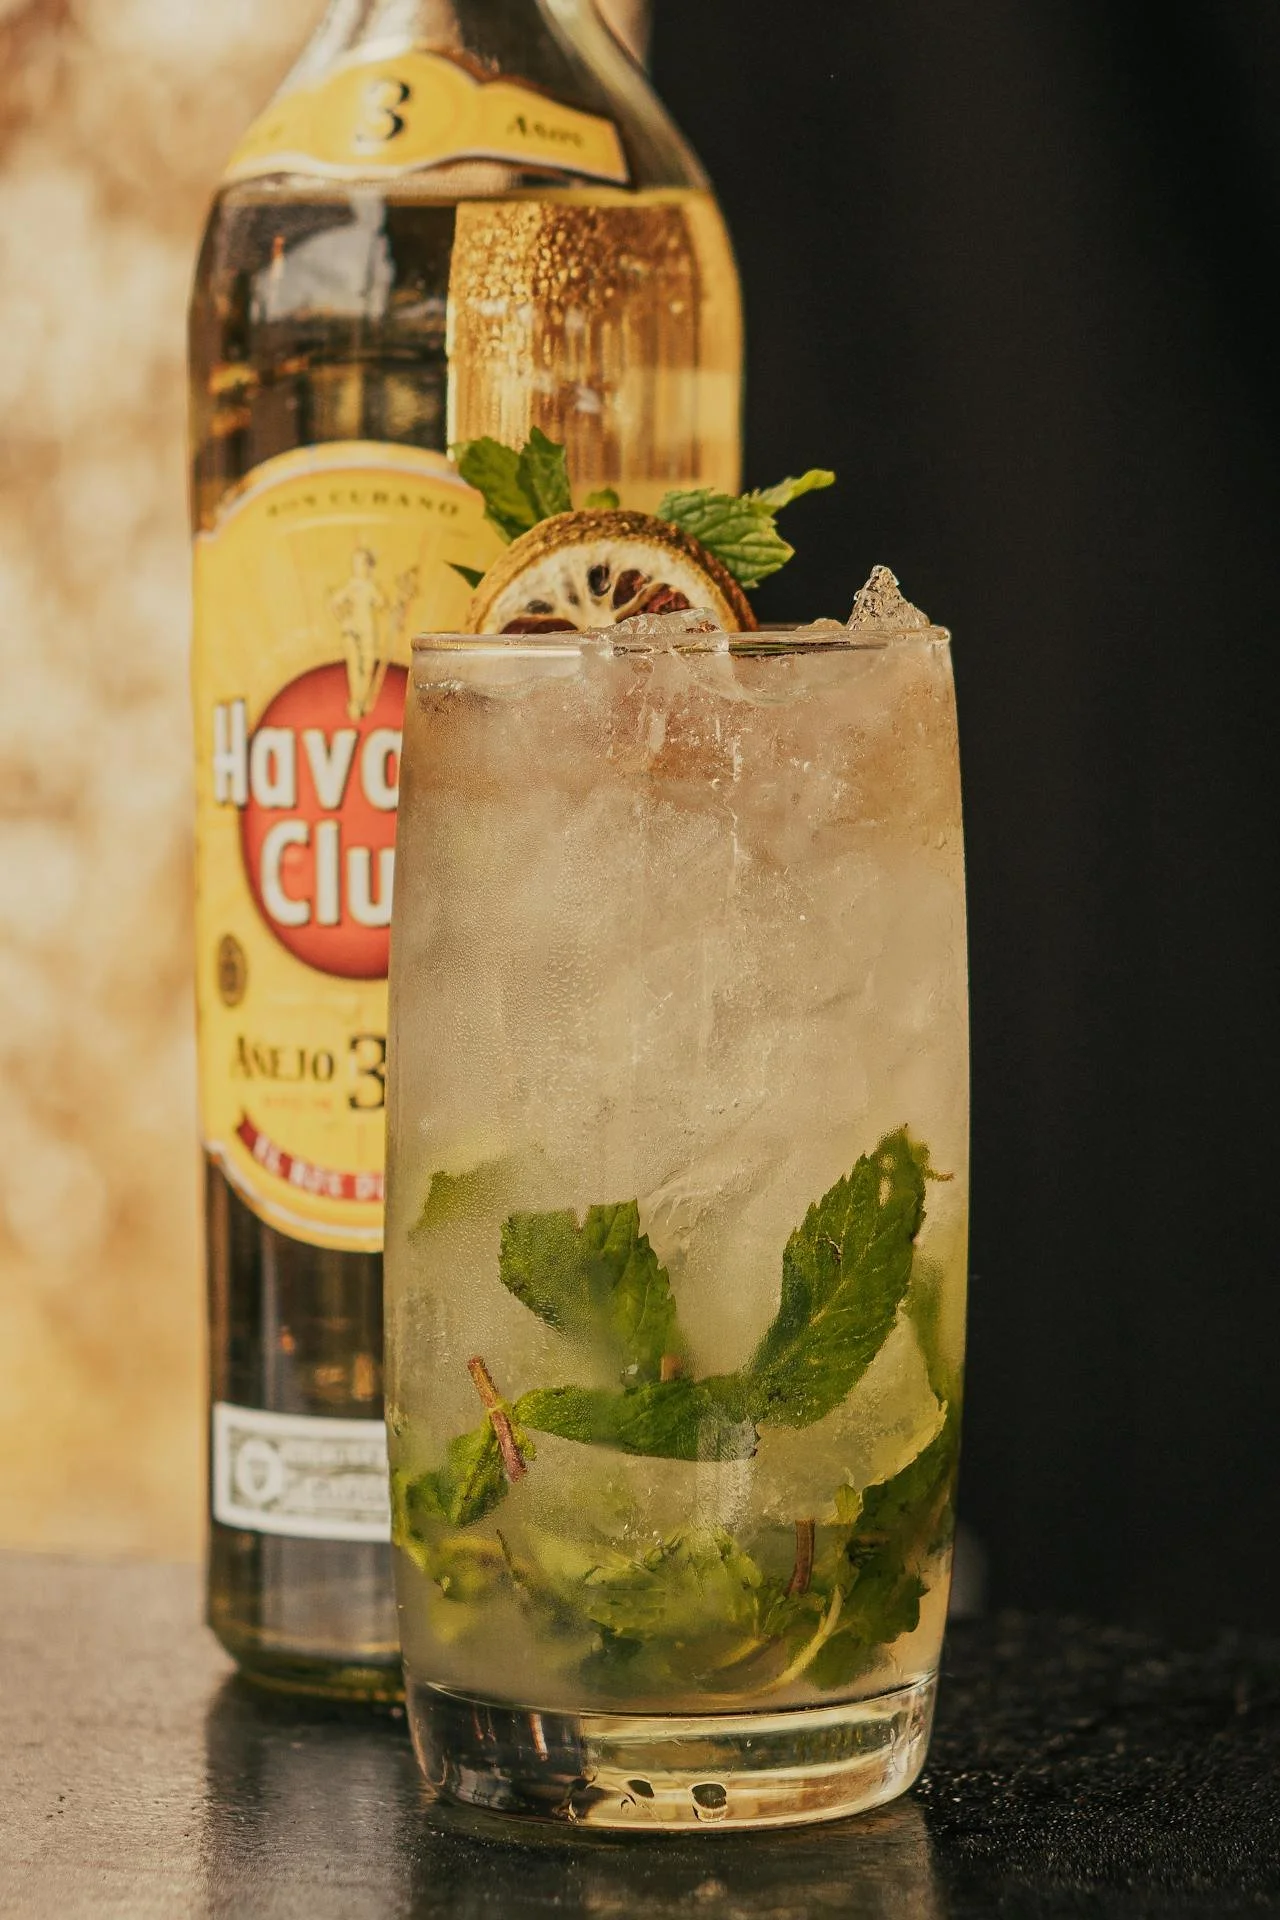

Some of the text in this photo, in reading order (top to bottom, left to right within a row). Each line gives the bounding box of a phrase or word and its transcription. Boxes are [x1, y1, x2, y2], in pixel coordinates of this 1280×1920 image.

[355, 77, 411, 152] 3
[213, 697, 403, 811] Hava
[260, 818, 396, 926] Clu
